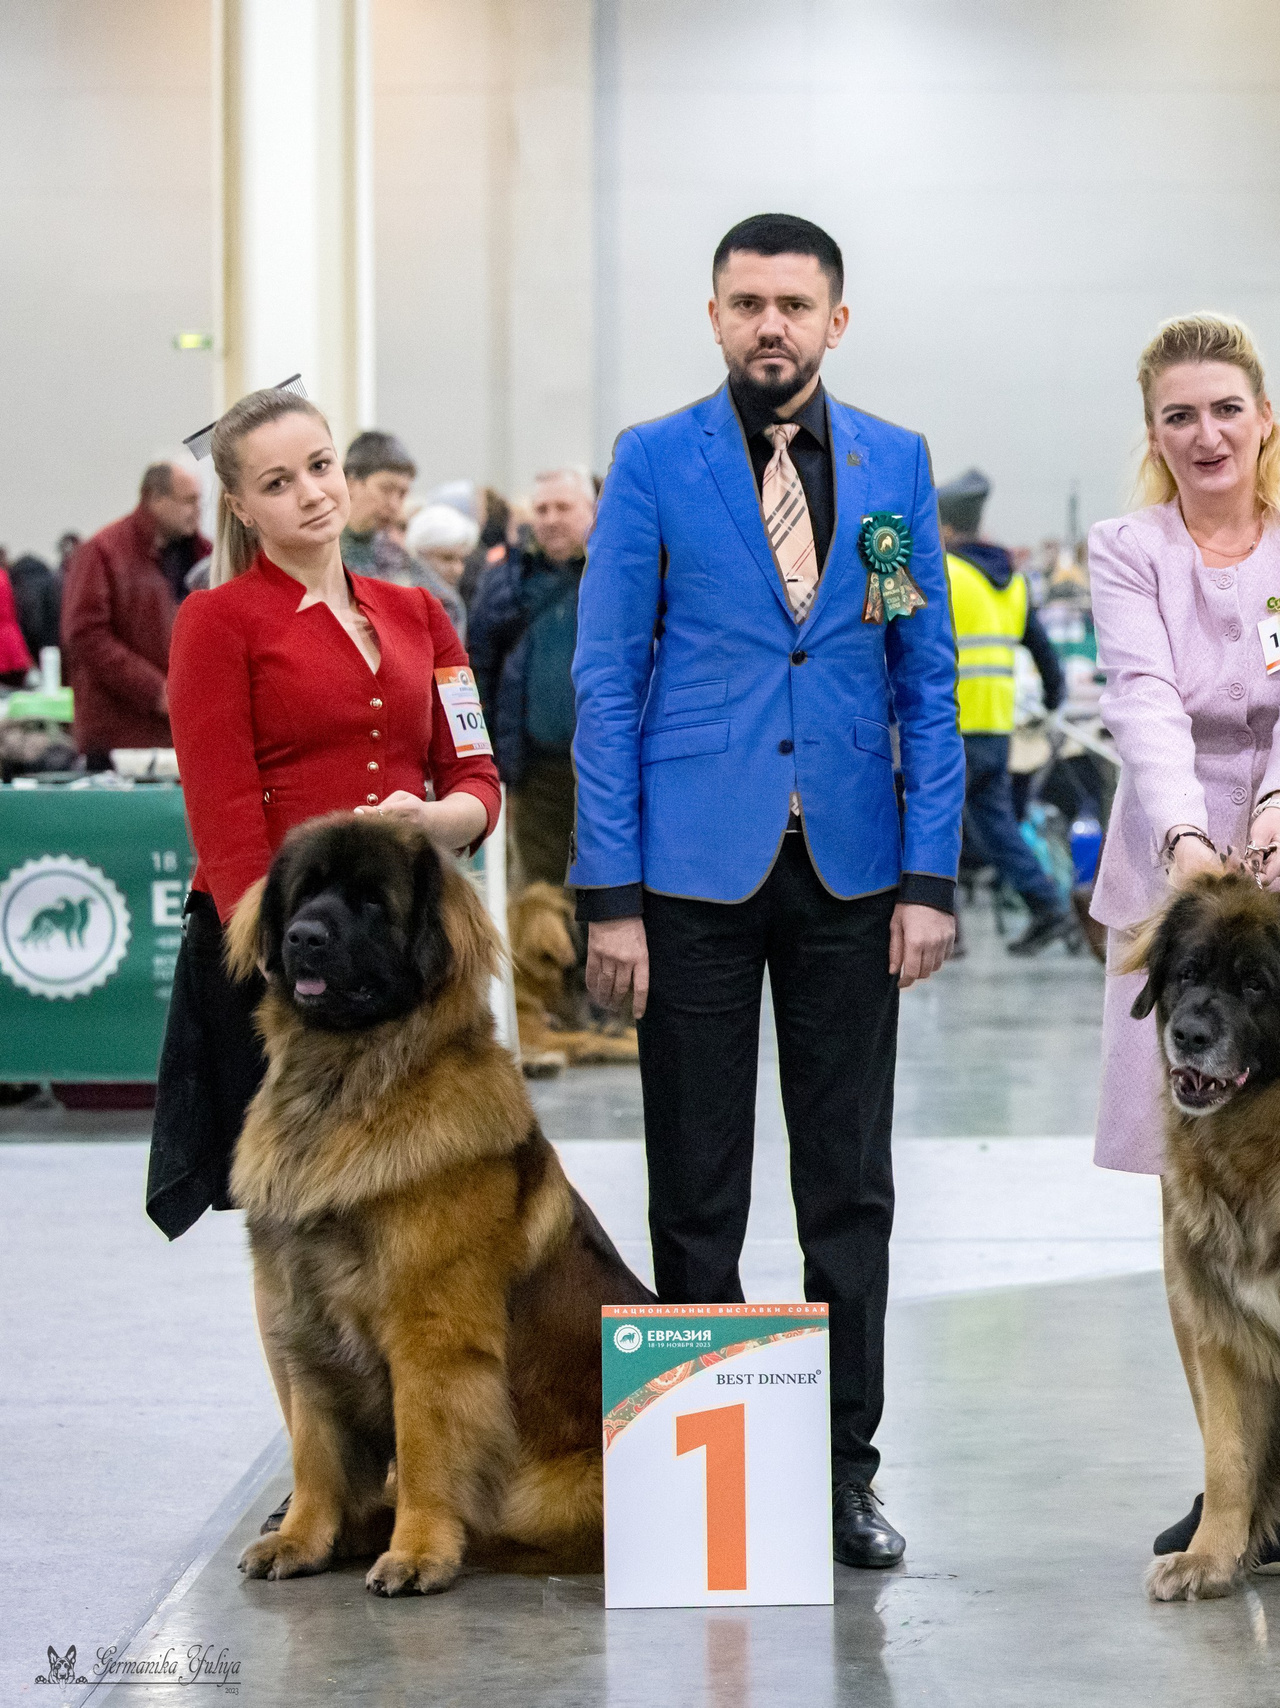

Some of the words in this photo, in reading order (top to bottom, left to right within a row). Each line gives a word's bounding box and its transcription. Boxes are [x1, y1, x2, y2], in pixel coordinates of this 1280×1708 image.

[613, 1307, 711, 1315] НАЦИОНАЛЬНЫЕ
[718, 1306, 781, 1314] ВЫСТАВКИ
[647, 1329, 712, 1342] ЕВРАЗИЯ
[716, 1373, 755, 1385] BEST
[676, 1403, 748, 1591] 1
